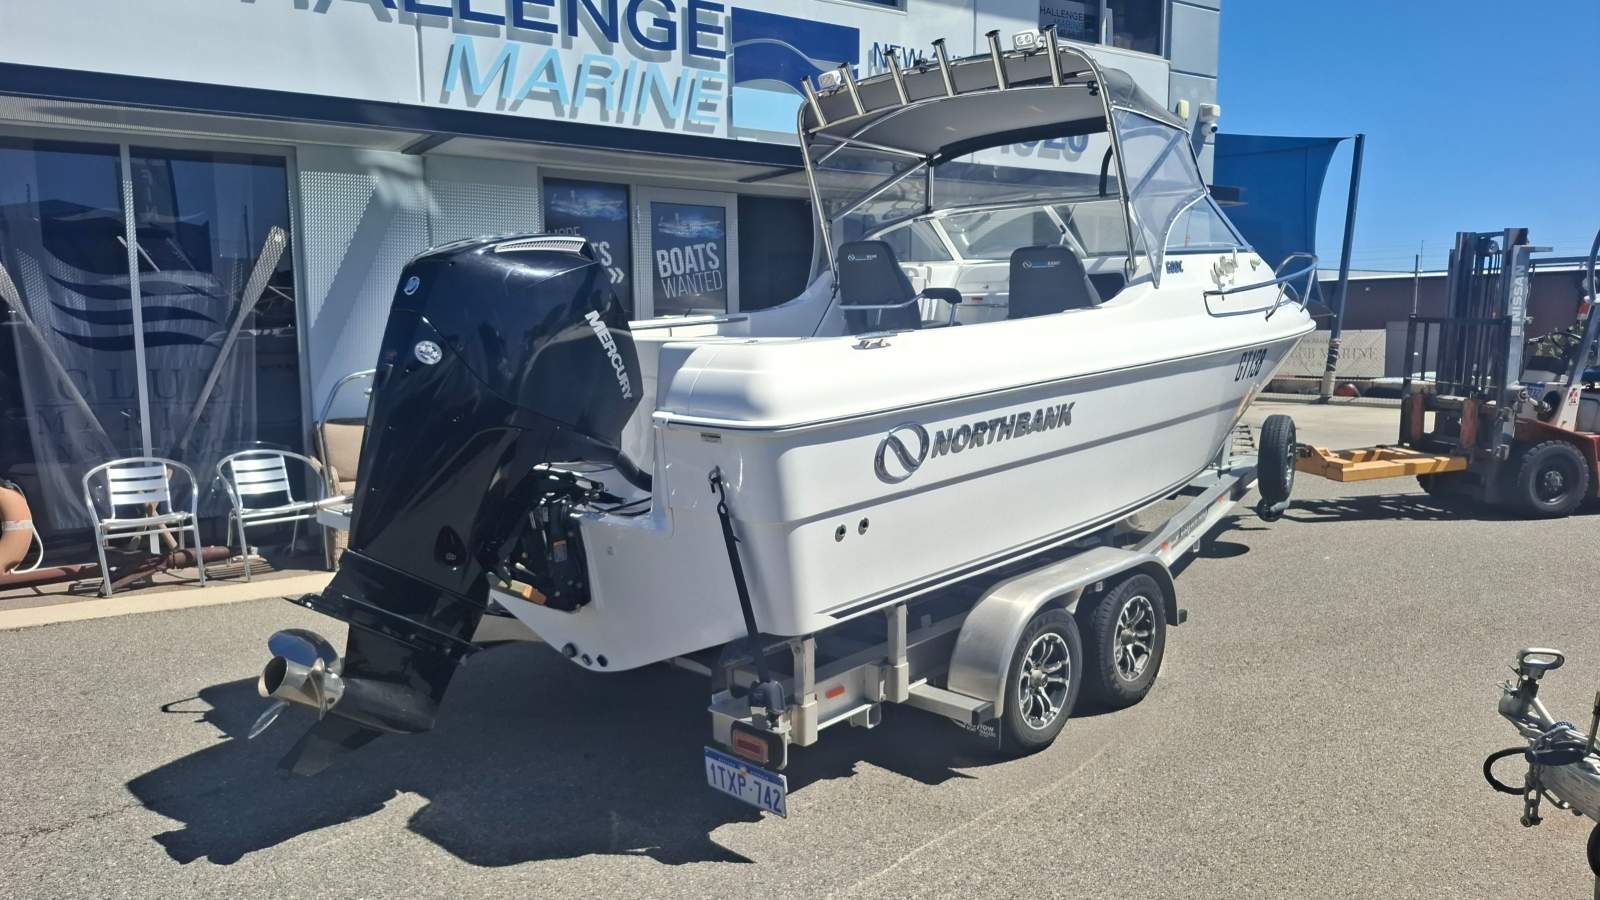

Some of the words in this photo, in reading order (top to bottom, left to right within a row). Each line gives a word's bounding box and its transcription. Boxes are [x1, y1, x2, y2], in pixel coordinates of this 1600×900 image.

[445, 36, 727, 123] MARINE
[656, 241, 720, 278] BOATS
[661, 269, 723, 299] WANTED
[1511, 264, 1526, 322] NISSAN
[584, 310, 633, 399] MERCURY
[1320, 346, 1377, 360] MRINE
[931, 401, 1076, 459] NORTHBANK
